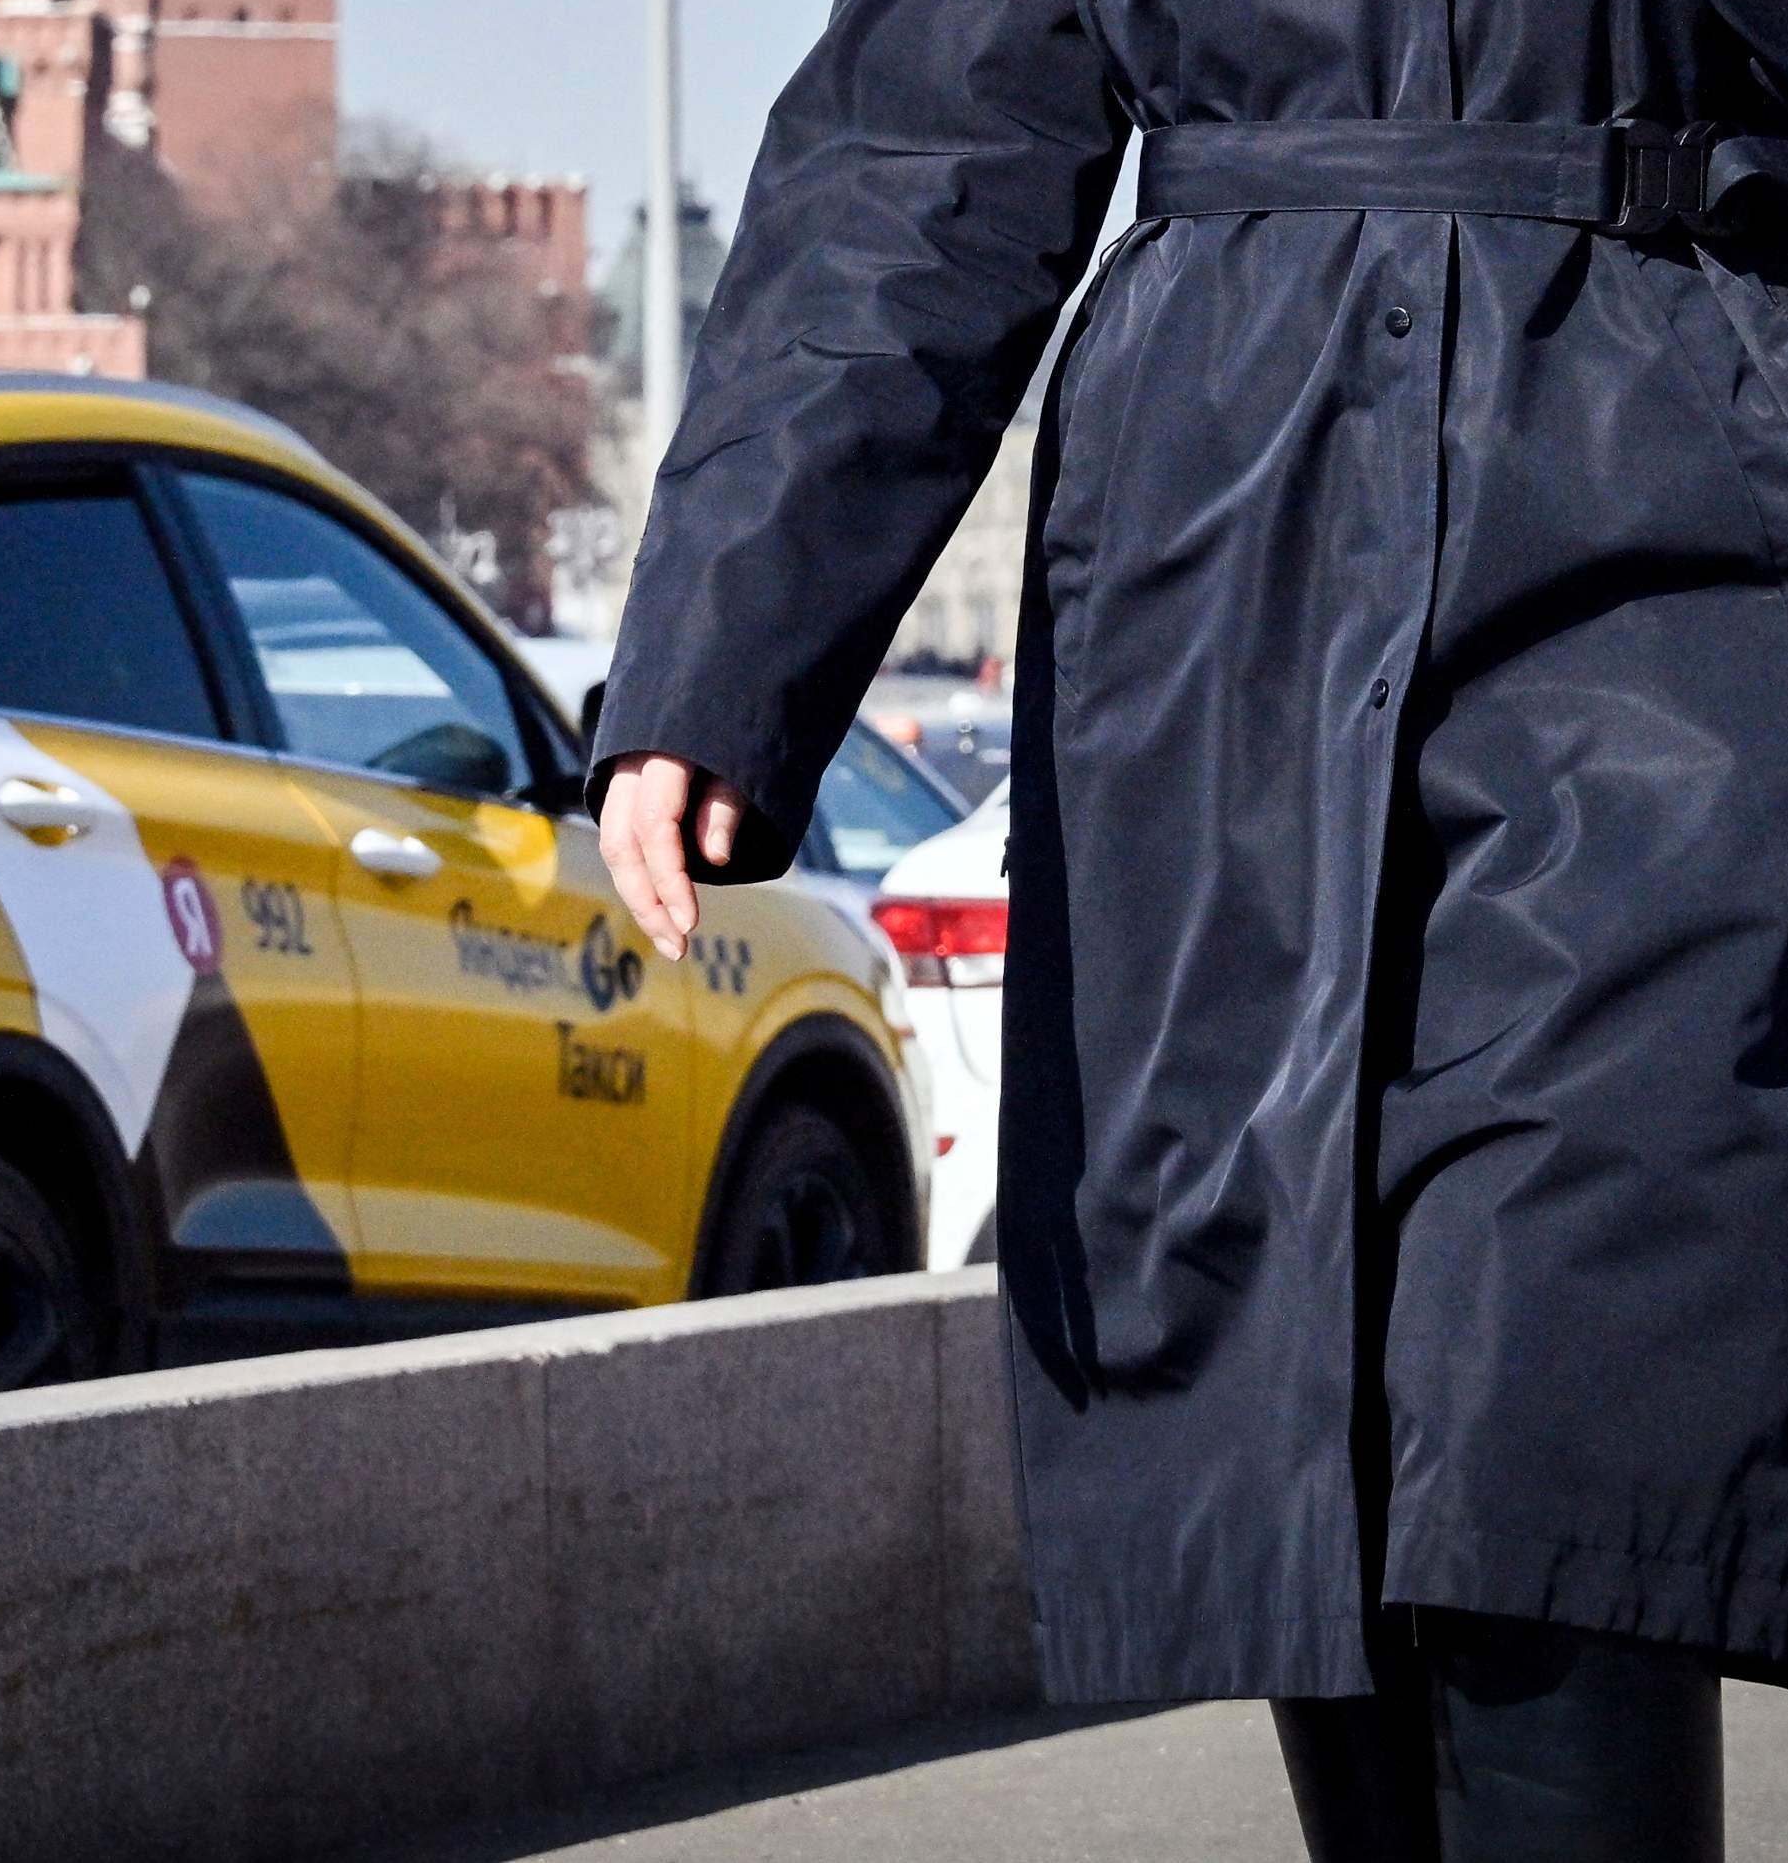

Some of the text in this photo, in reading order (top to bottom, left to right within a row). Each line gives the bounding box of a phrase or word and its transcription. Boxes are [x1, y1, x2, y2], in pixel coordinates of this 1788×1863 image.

[241, 876, 313, 957] 992
[581, 911, 644, 1012] Go
[557, 1018, 646, 1105] Такси
